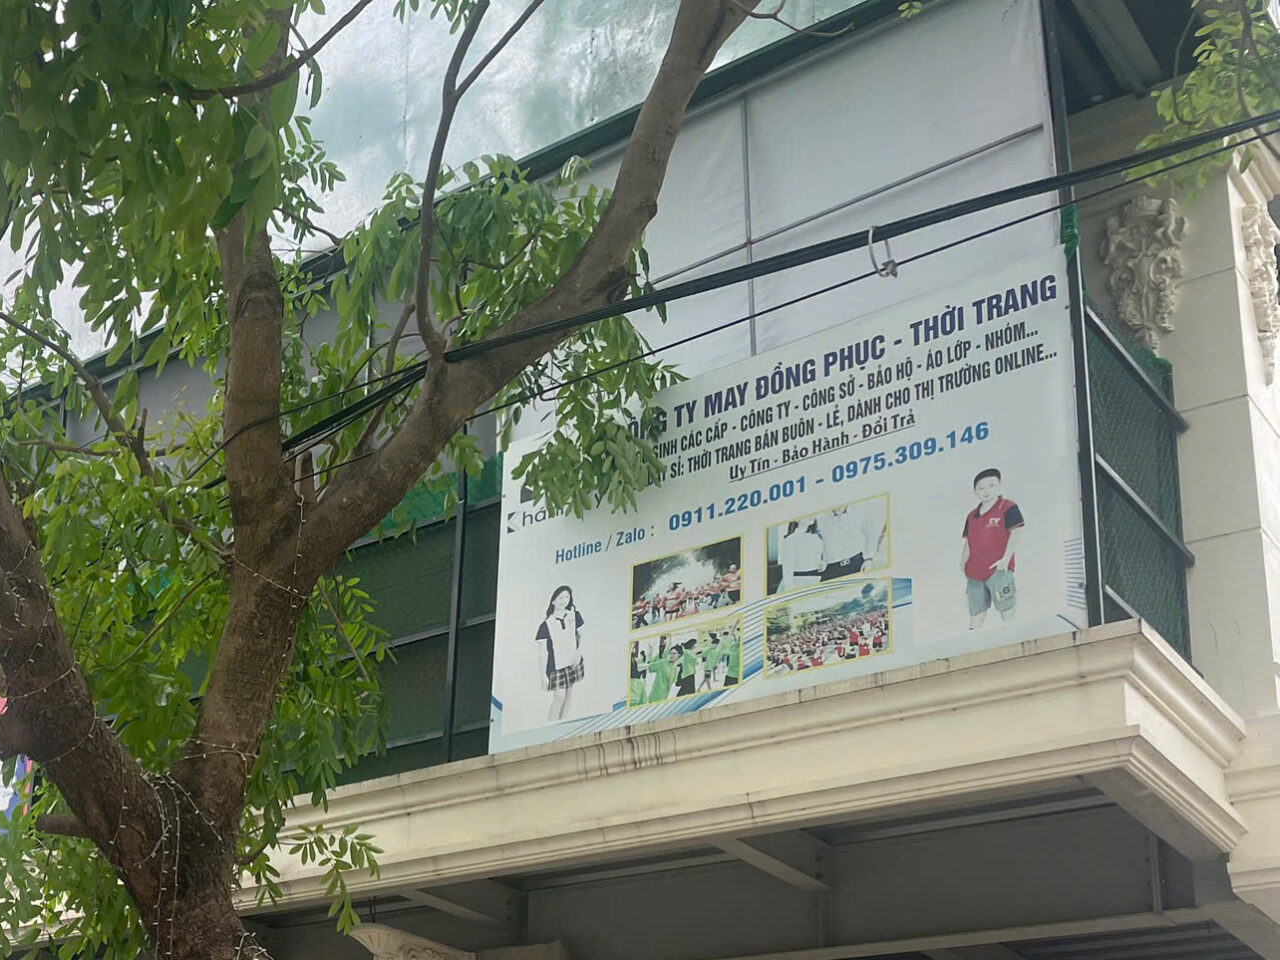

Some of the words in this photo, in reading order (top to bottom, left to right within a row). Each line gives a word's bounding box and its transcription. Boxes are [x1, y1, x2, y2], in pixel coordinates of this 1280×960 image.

[674, 399, 697, 428] TY
[704, 381, 749, 418] MAY
[755, 357, 815, 401] ĐỒNG
[824, 335, 885, 377] PHỤC
[910, 305, 964, 346] THỜI
[972, 275, 1057, 325] TRANG
[681, 428, 702, 452] CÁC
[706, 419, 728, 444] CẤP
[740, 409, 773, 432] CÔNG
[777, 400, 791, 420] TY
[803, 386, 835, 411] CÔNG
[839, 374, 855, 397] SỞ
[867, 366, 892, 390] BẢO
[896, 357, 913, 382] HỘ
[926, 347, 943, 371] ÁO
[948, 339, 971, 363] LỚP
[688, 451, 712, 474] THỜI
[715, 439, 751, 464] TRANG
[755, 427, 778, 451] BÁN
[782, 418, 814, 443] BUÔN
[848, 395, 881, 422] DÀNH
[885, 386, 910, 410] CHO
[915, 378, 934, 400] THỊ
[938, 361, 990, 393] TRƯỜNG
[729, 465, 746, 481] Uy
[750, 458, 770, 474] Tín
[783, 444, 808, 464] Bảo
[813, 431, 849, 452] Hành
[862, 418, 887, 439] Đổi
[892, 409, 915, 429] Trả
[670, 476, 806, 531] 0911.220.001
[832, 421, 990, 483] 0975.309.146
[555, 539, 602, 564] Hotline
[616, 527, 645, 547] Zalo
